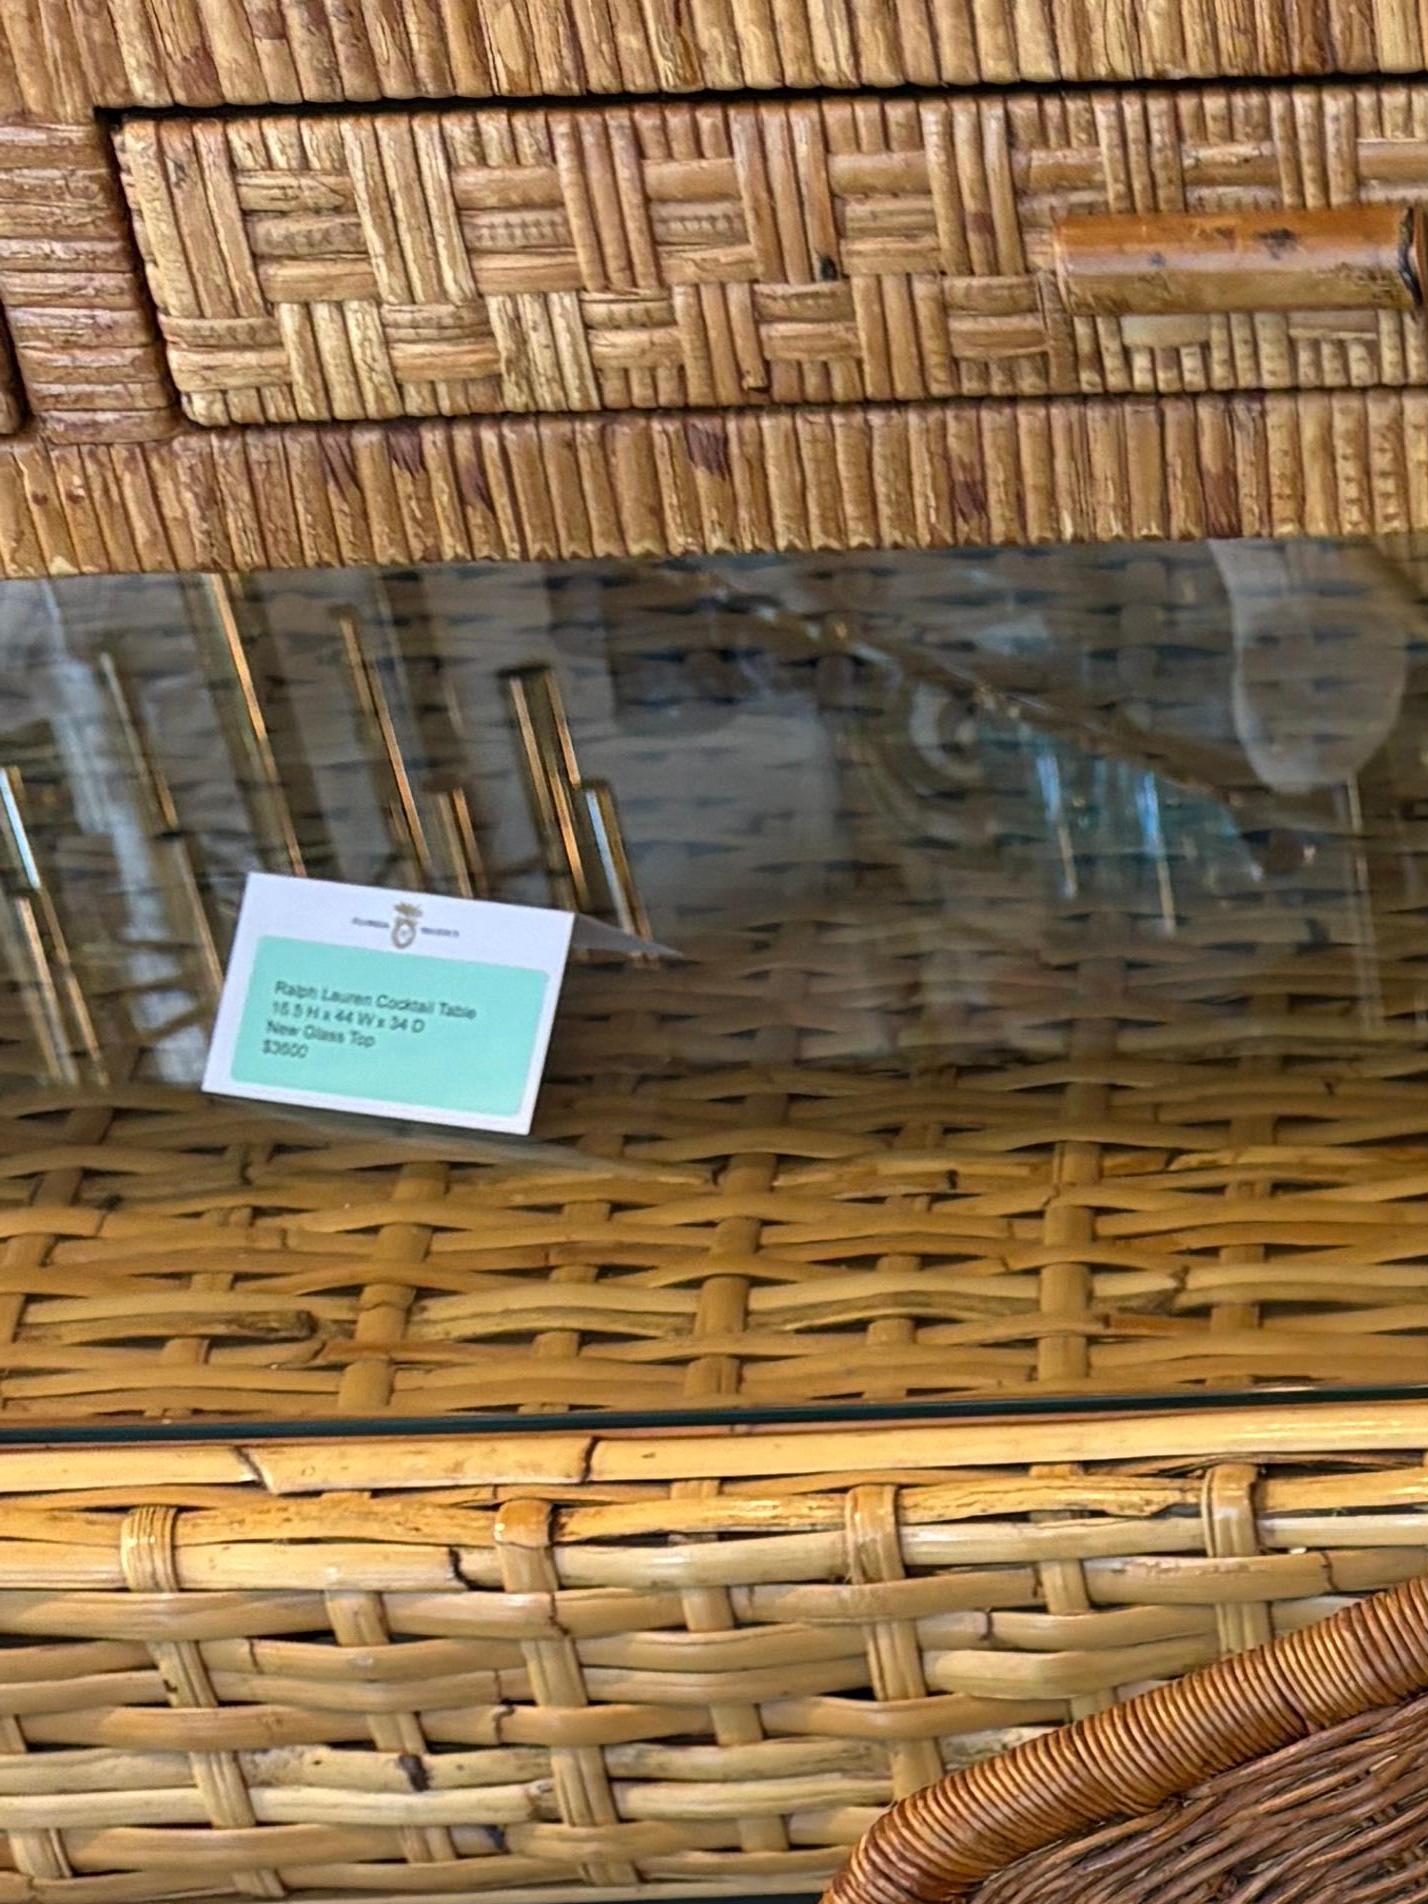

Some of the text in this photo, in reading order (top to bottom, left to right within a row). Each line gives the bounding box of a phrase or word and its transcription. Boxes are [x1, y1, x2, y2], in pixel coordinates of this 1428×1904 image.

[275, 981, 477, 1019] Ralph Lauren Cocktail Table
[266, 1019, 375, 1048] New Glass Top
[357, 1012, 377, 1026] W
